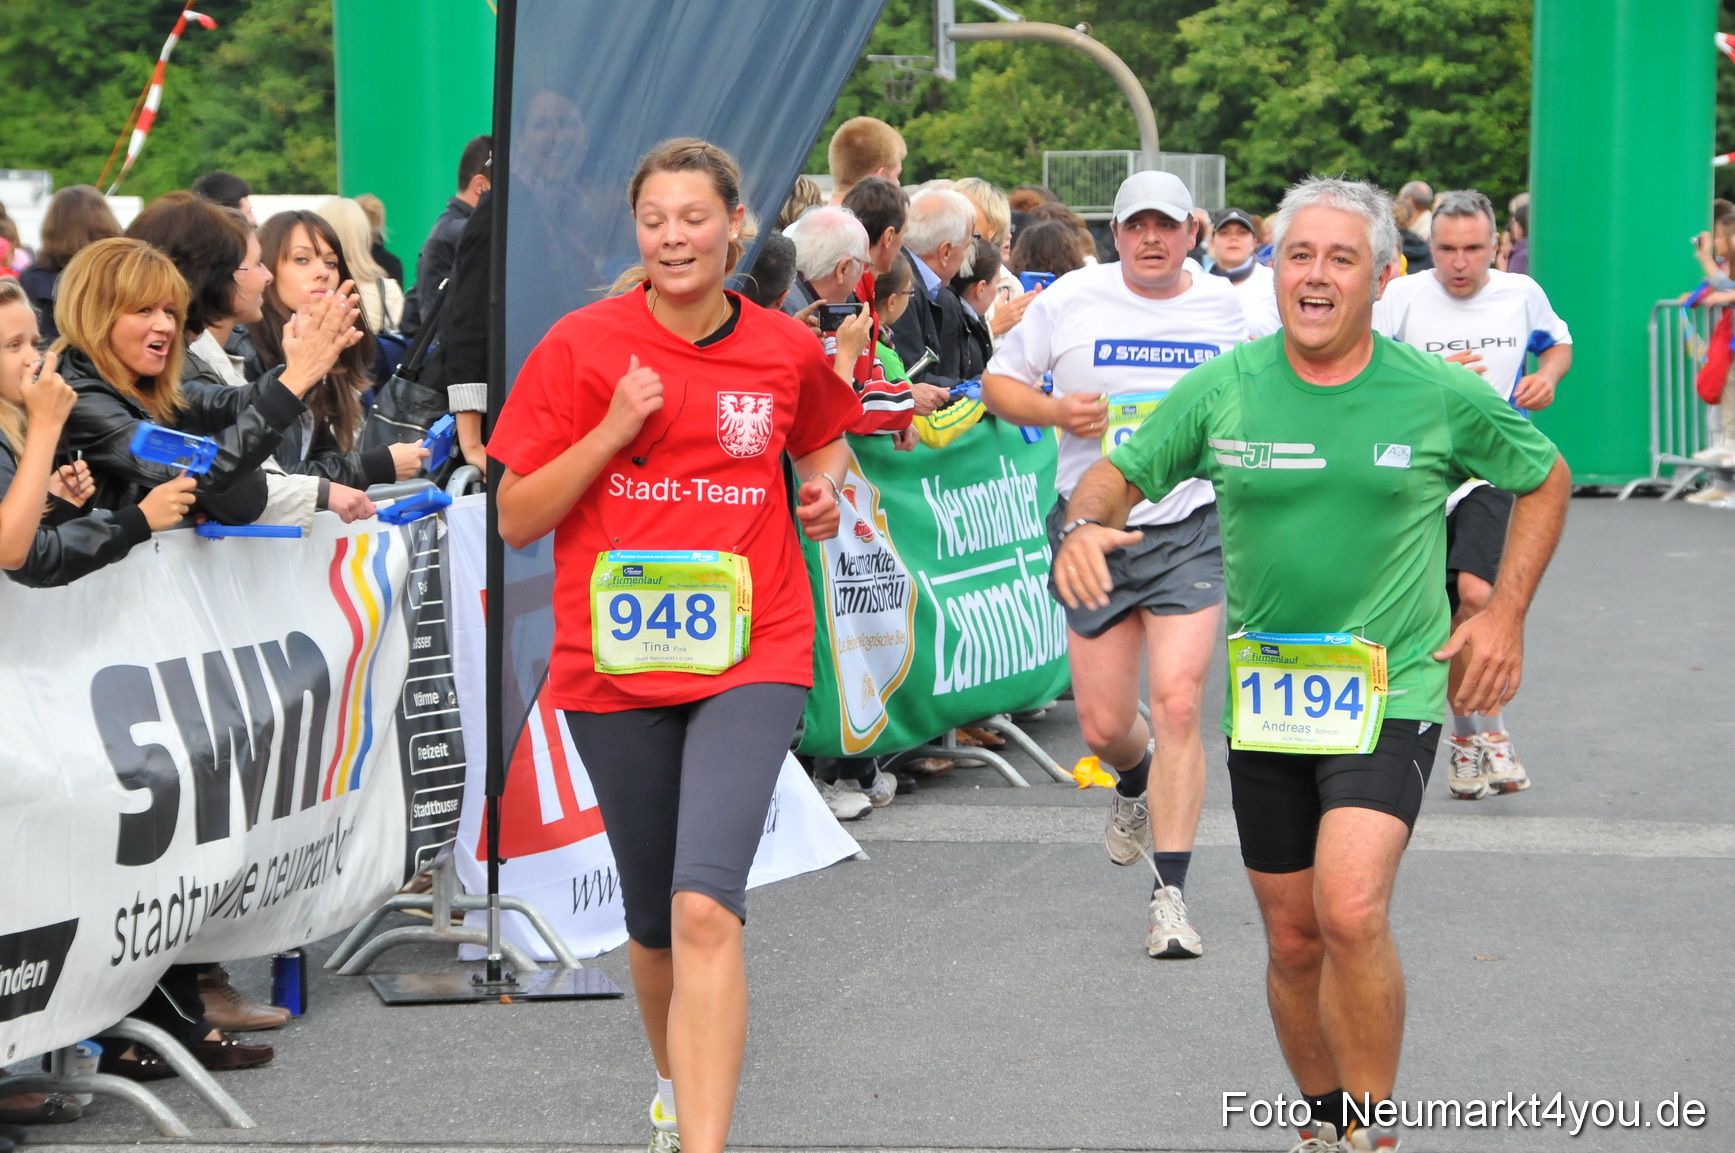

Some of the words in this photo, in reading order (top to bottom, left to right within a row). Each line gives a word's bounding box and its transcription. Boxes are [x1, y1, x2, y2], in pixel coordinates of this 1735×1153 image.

[1426, 337, 1517, 353] DELPHI
[1115, 345, 1215, 363] STAEDTLER
[608, 472, 767, 505] Stadt-Team
[921, 454, 1044, 561] Neumarkter
[612, 575, 663, 585] firmenlauf
[609, 593, 717, 641] 948
[642, 642, 670, 652] Tina
[1251, 651, 1299, 665] firmenlauf
[1241, 671, 1364, 720] 1194
[1262, 720, 1311, 734] Andreas
